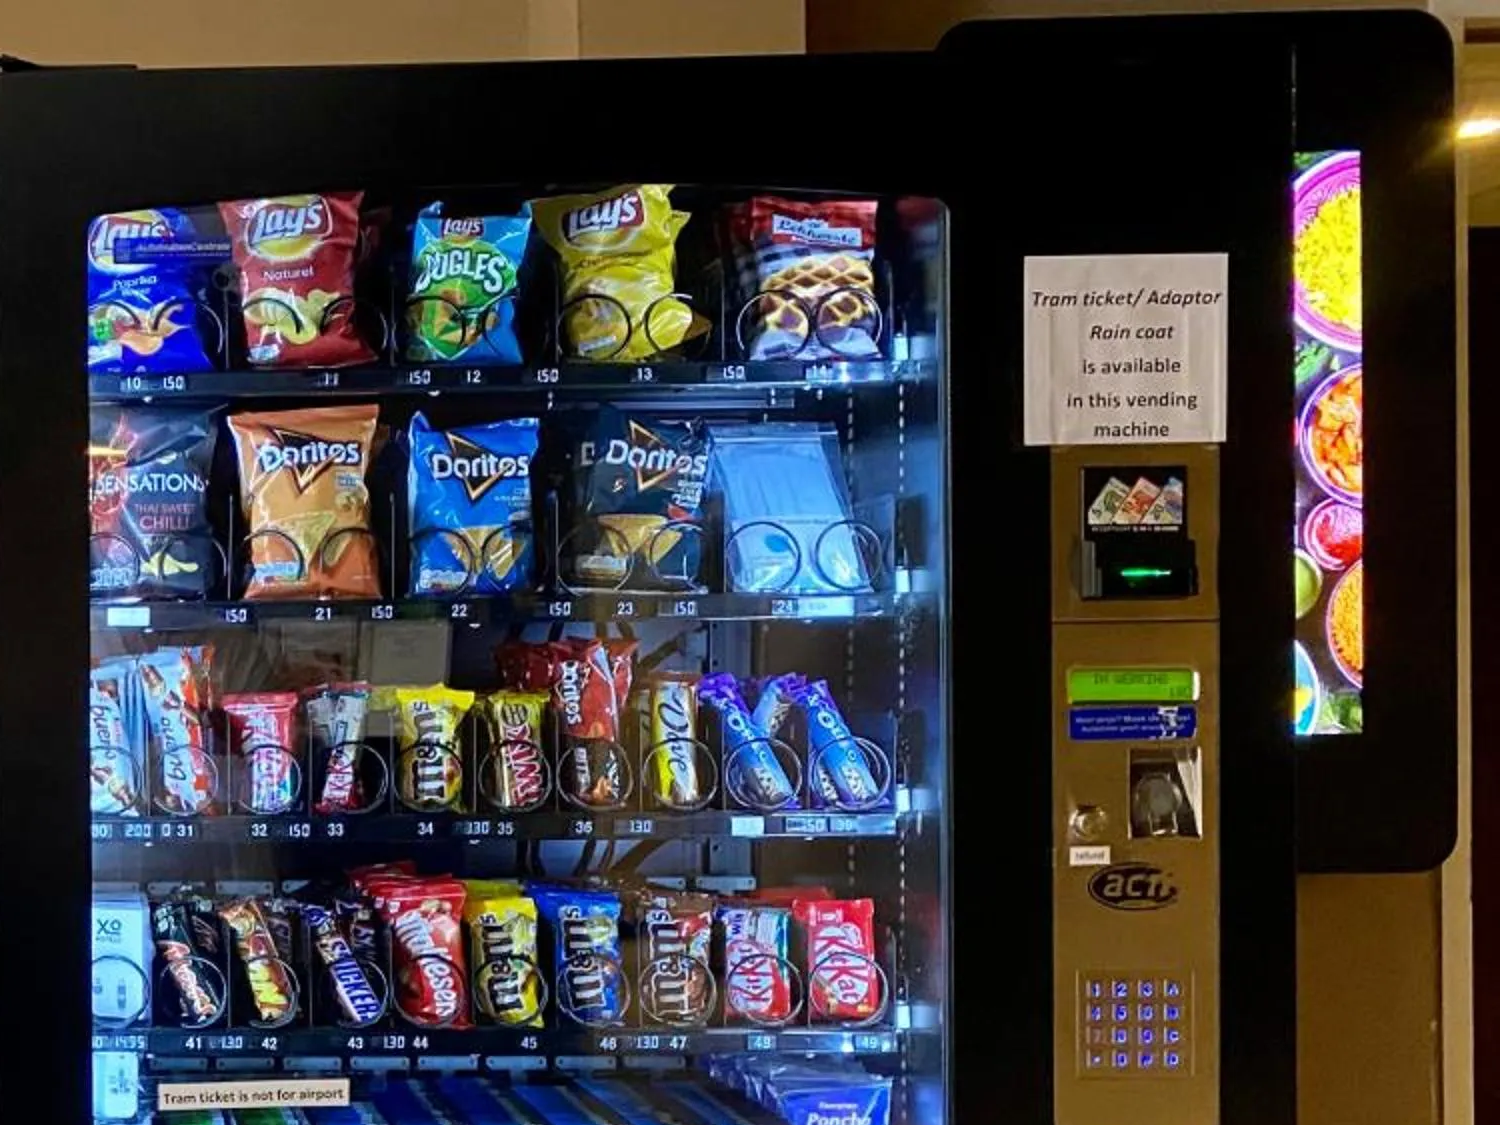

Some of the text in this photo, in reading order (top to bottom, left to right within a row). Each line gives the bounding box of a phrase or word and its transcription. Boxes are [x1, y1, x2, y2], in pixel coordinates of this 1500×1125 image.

[1032, 291, 1077, 307] Tram
[1146, 289, 1222, 308] Adaptor
[1090, 324, 1174, 340] Rain coat
[1083, 357, 1181, 374] is available
[466, 370, 481, 383] 12
[637, 367, 653, 381] 13
[1067, 391, 1198, 410] in this vending
[1094, 421, 1169, 437] machine
[259, 441, 361, 473] Doritos
[605, 439, 708, 475] Doritos
[432, 453, 529, 479] Doritos
[315, 606, 332, 621] 21
[451, 603, 468, 618] 22
[617, 601, 634, 616] 23
[177, 823, 194, 837] 31
[251, 823, 268, 837] 32
[327, 822, 345, 837] 33
[417, 821, 434, 836] 34
[185, 1035, 202, 1049] 41
[261, 1036, 278, 1051] 42
[347, 1036, 364, 1050] 43
[413, 1036, 429, 1050] 44
[521, 1036, 538, 1050] 45
[669, 1035, 687, 1049] 47
[164, 1087, 345, 1105] Tram ticket is not for airport
